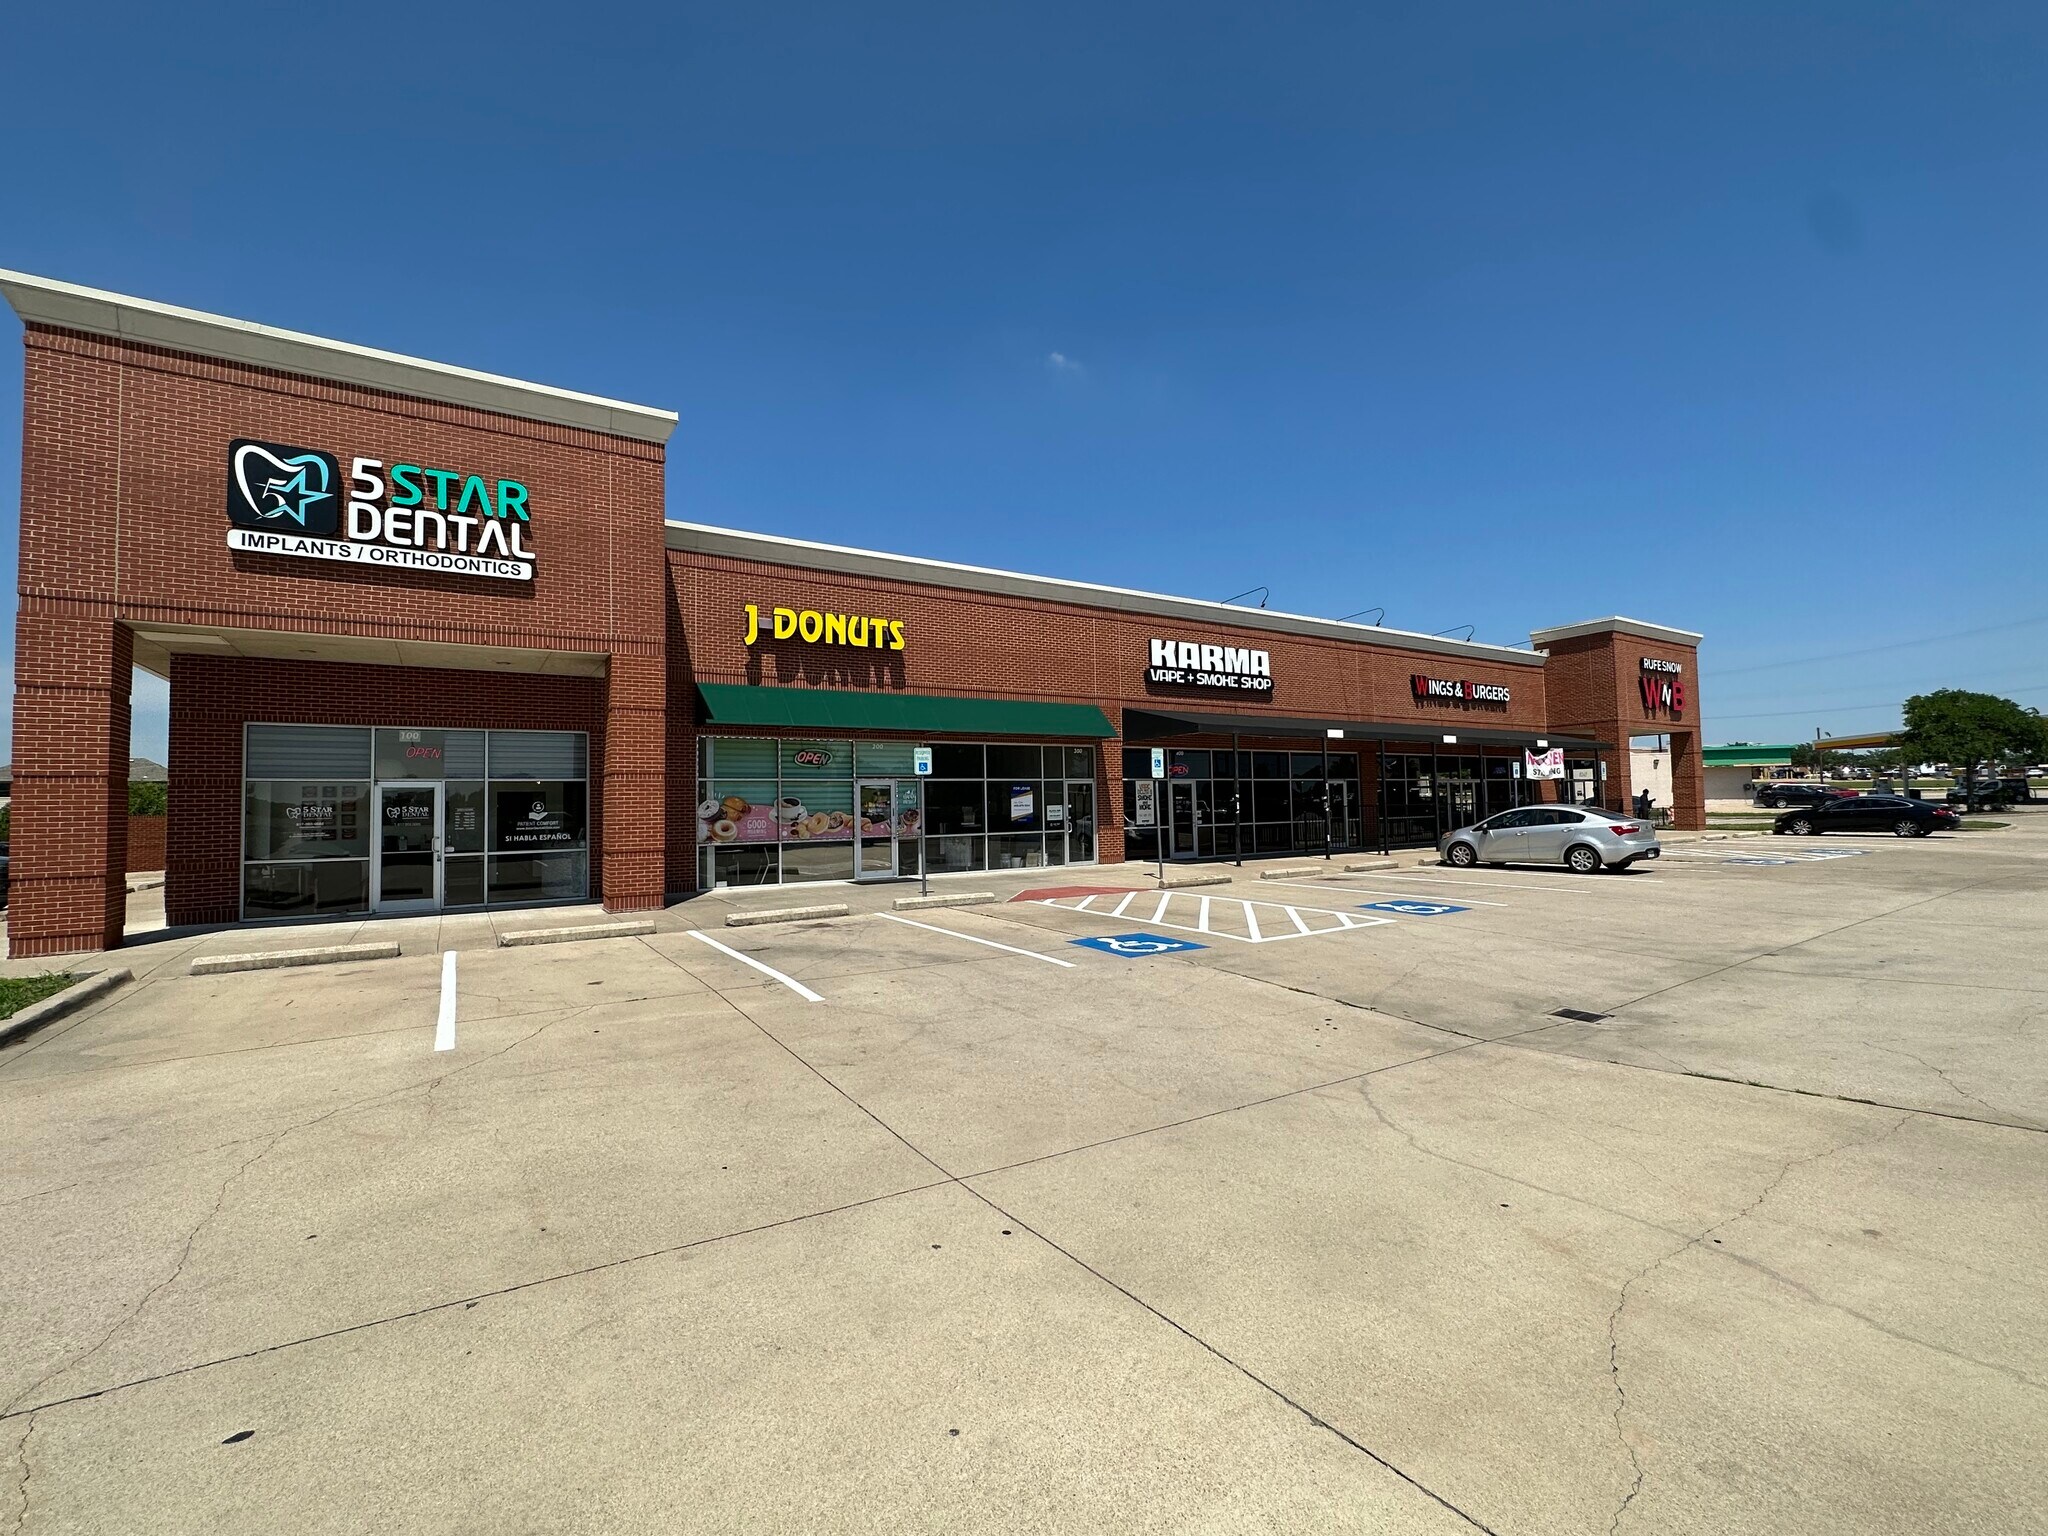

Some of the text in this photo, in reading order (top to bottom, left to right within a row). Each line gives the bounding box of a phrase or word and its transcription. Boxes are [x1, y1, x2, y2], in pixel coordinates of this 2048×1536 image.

[351, 457, 530, 521] 5 STAR
[348, 501, 536, 559] DENTAL
[241, 533, 352, 559] IMPLANTS
[369, 548, 522, 577] ORTHODONTICS
[743, 604, 905, 651] J DONUTS
[1150, 638, 1271, 677] KARMA
[1150, 668, 1185, 683] VAPE
[1196, 673, 1239, 688] SMOKE
[1240, 677, 1272, 690] SHOP
[1415, 675, 1510, 702] WINGS & BURGERS
[401, 731, 419, 740] 100
[406, 746, 442, 759] OPEN
[797, 751, 829, 765] OPEN
[408, 805, 430, 813] STAR
[747, 819, 767, 829] GOOD
[513, 834, 538, 842] HABLA
[539, 832, 572, 841] ESPAÑOL
